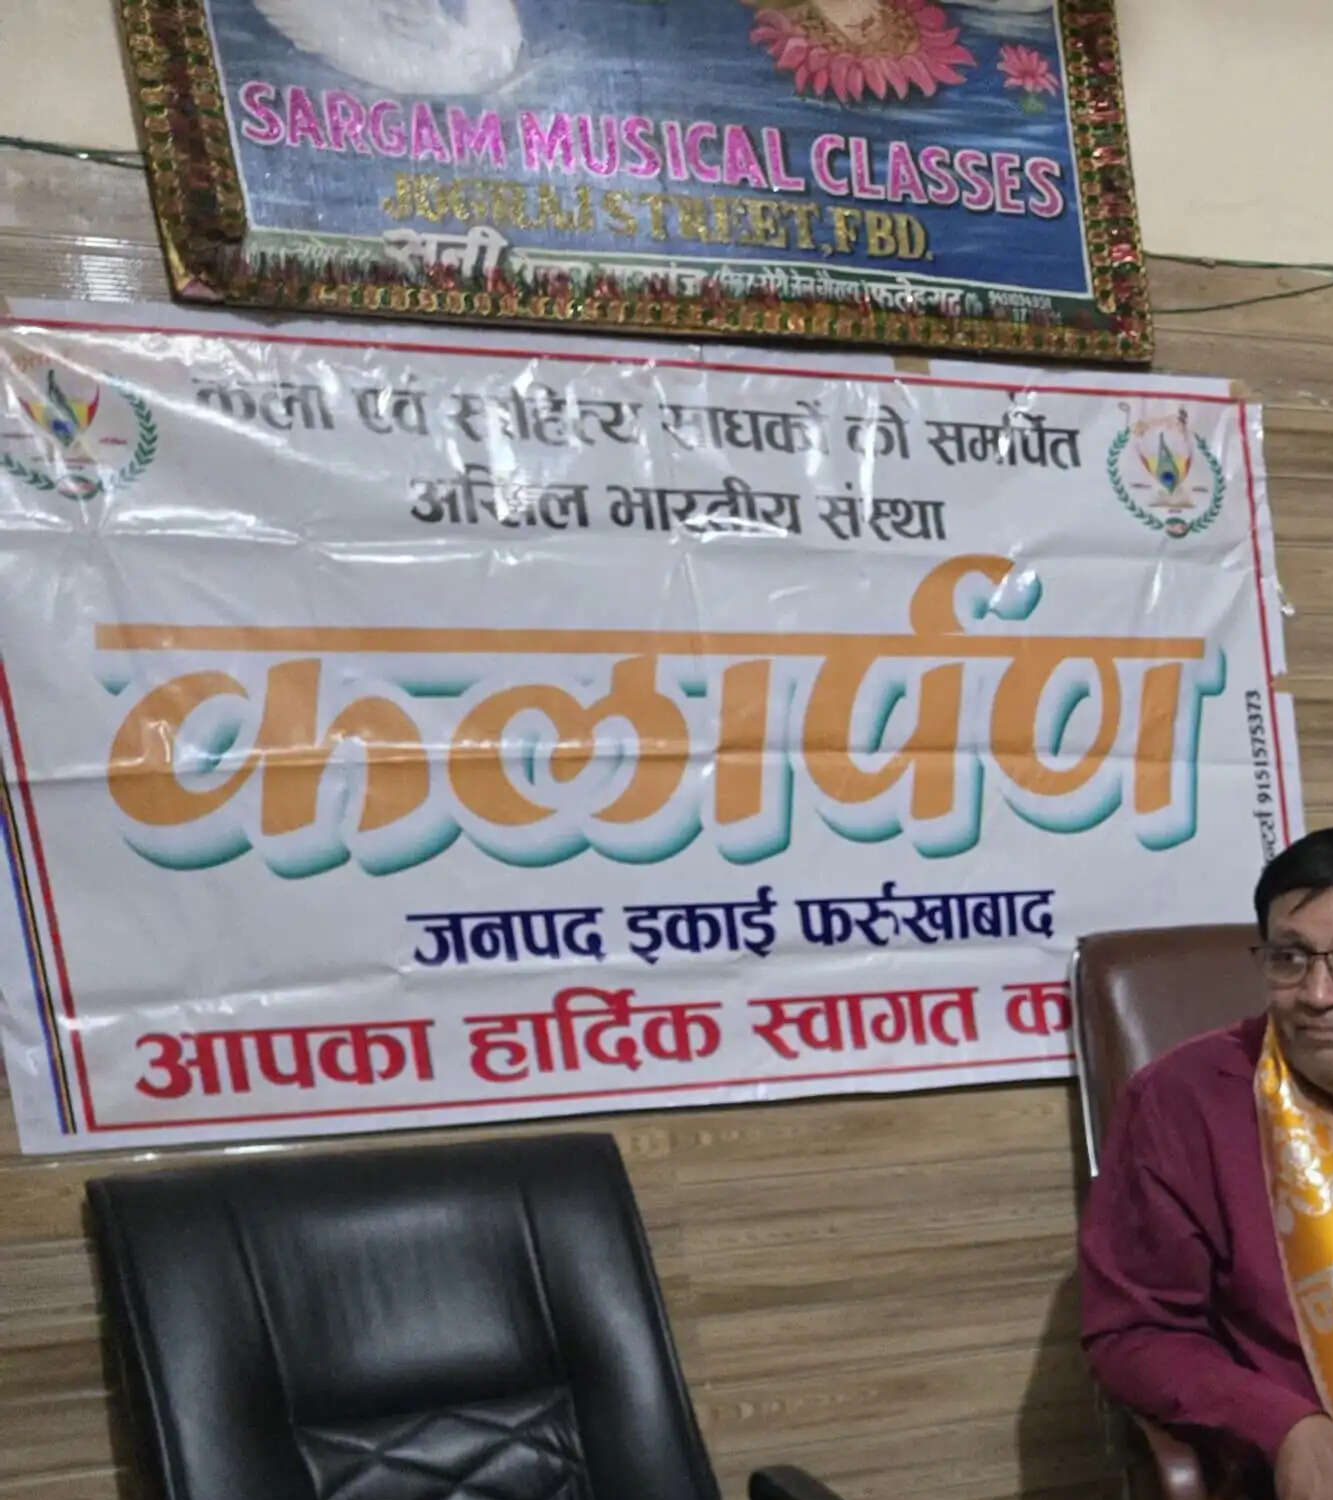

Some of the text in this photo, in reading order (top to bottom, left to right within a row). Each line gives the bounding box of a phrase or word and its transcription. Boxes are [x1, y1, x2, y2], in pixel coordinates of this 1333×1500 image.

[240, 80, 1065, 219] SARGAM MUSICAL CLASSES
[606, 475, 801, 534] भारतीय
[817, 482, 947, 541] संस्था
[95, 553, 1226, 878] कलार्पण
[1244, 690, 1273, 803] 9151575373
[405, 906, 604, 966] जनपद
[623, 885, 777, 964] इकाई
[134, 1018, 435, 1099] आपका
[463, 986, 722, 1083] हार्दिक
[748, 985, 979, 1059] स्वागत
